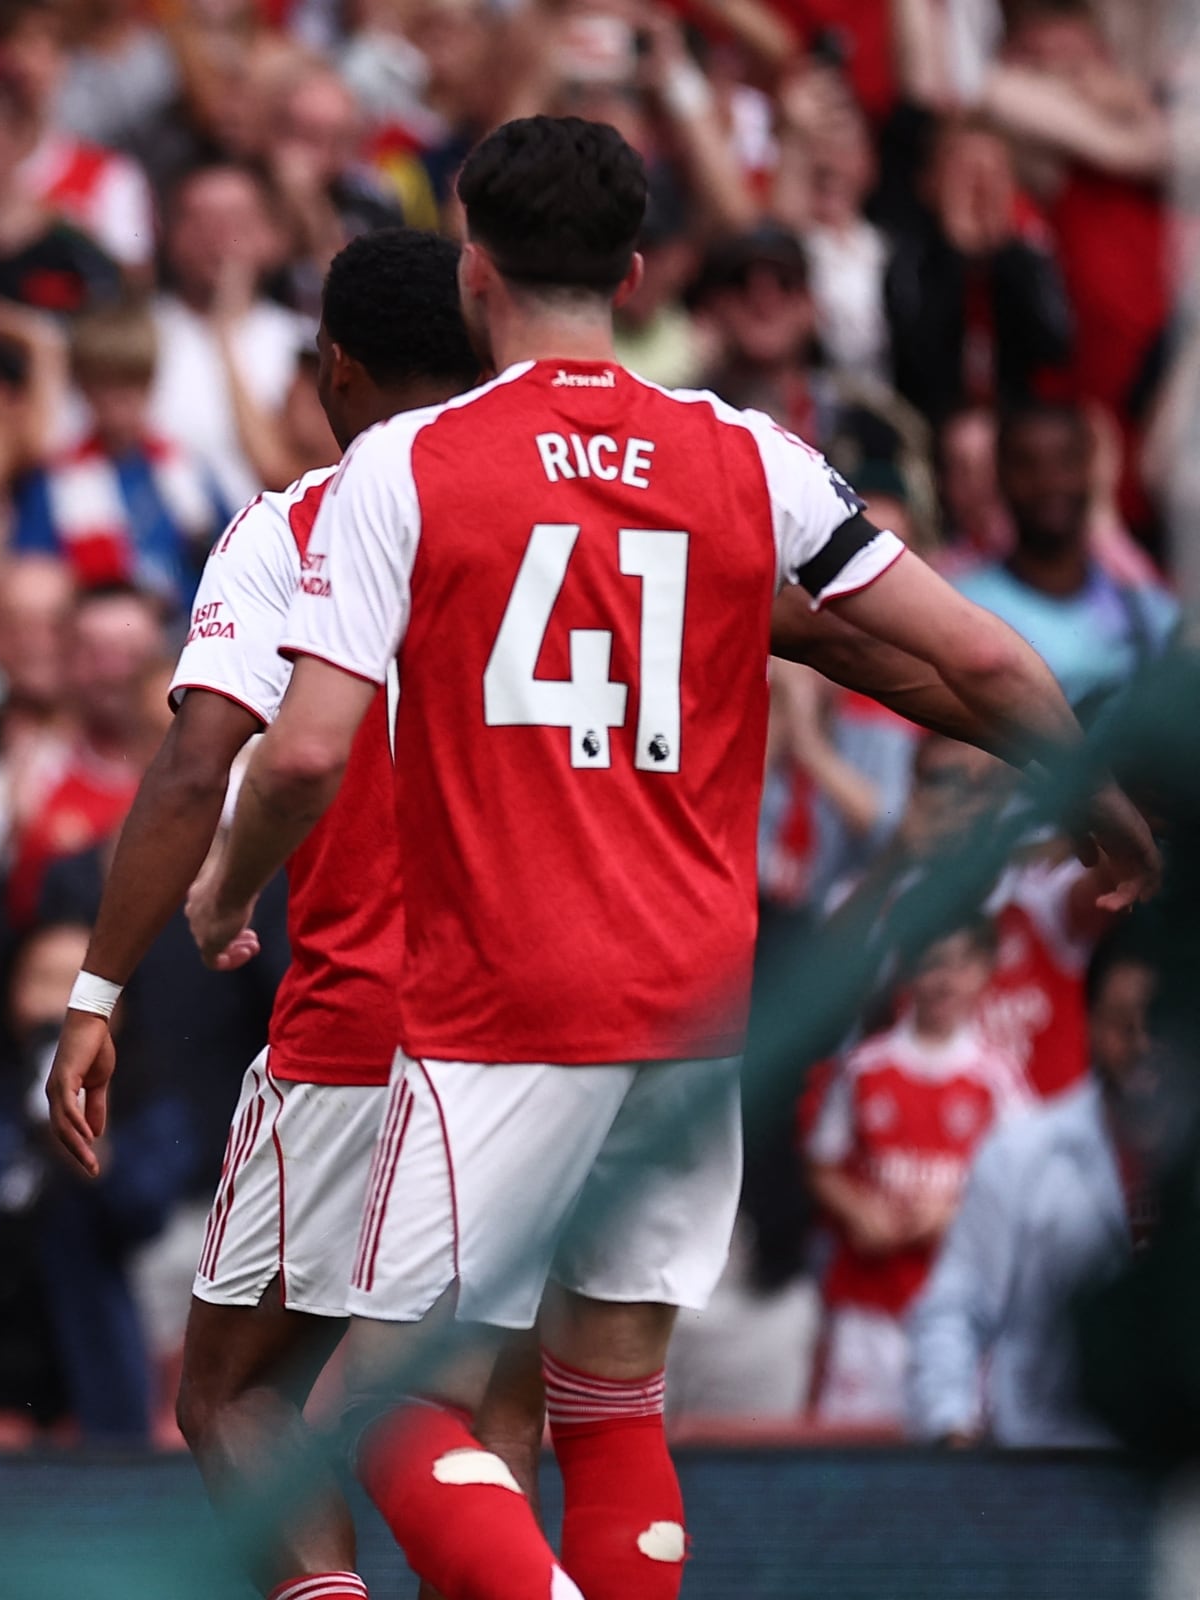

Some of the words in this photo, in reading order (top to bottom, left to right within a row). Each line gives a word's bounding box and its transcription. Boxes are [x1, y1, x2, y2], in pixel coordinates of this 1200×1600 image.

[551, 369, 616, 389] Arsenal
[535, 431, 656, 490] RICE
[482, 522, 690, 774] 41
